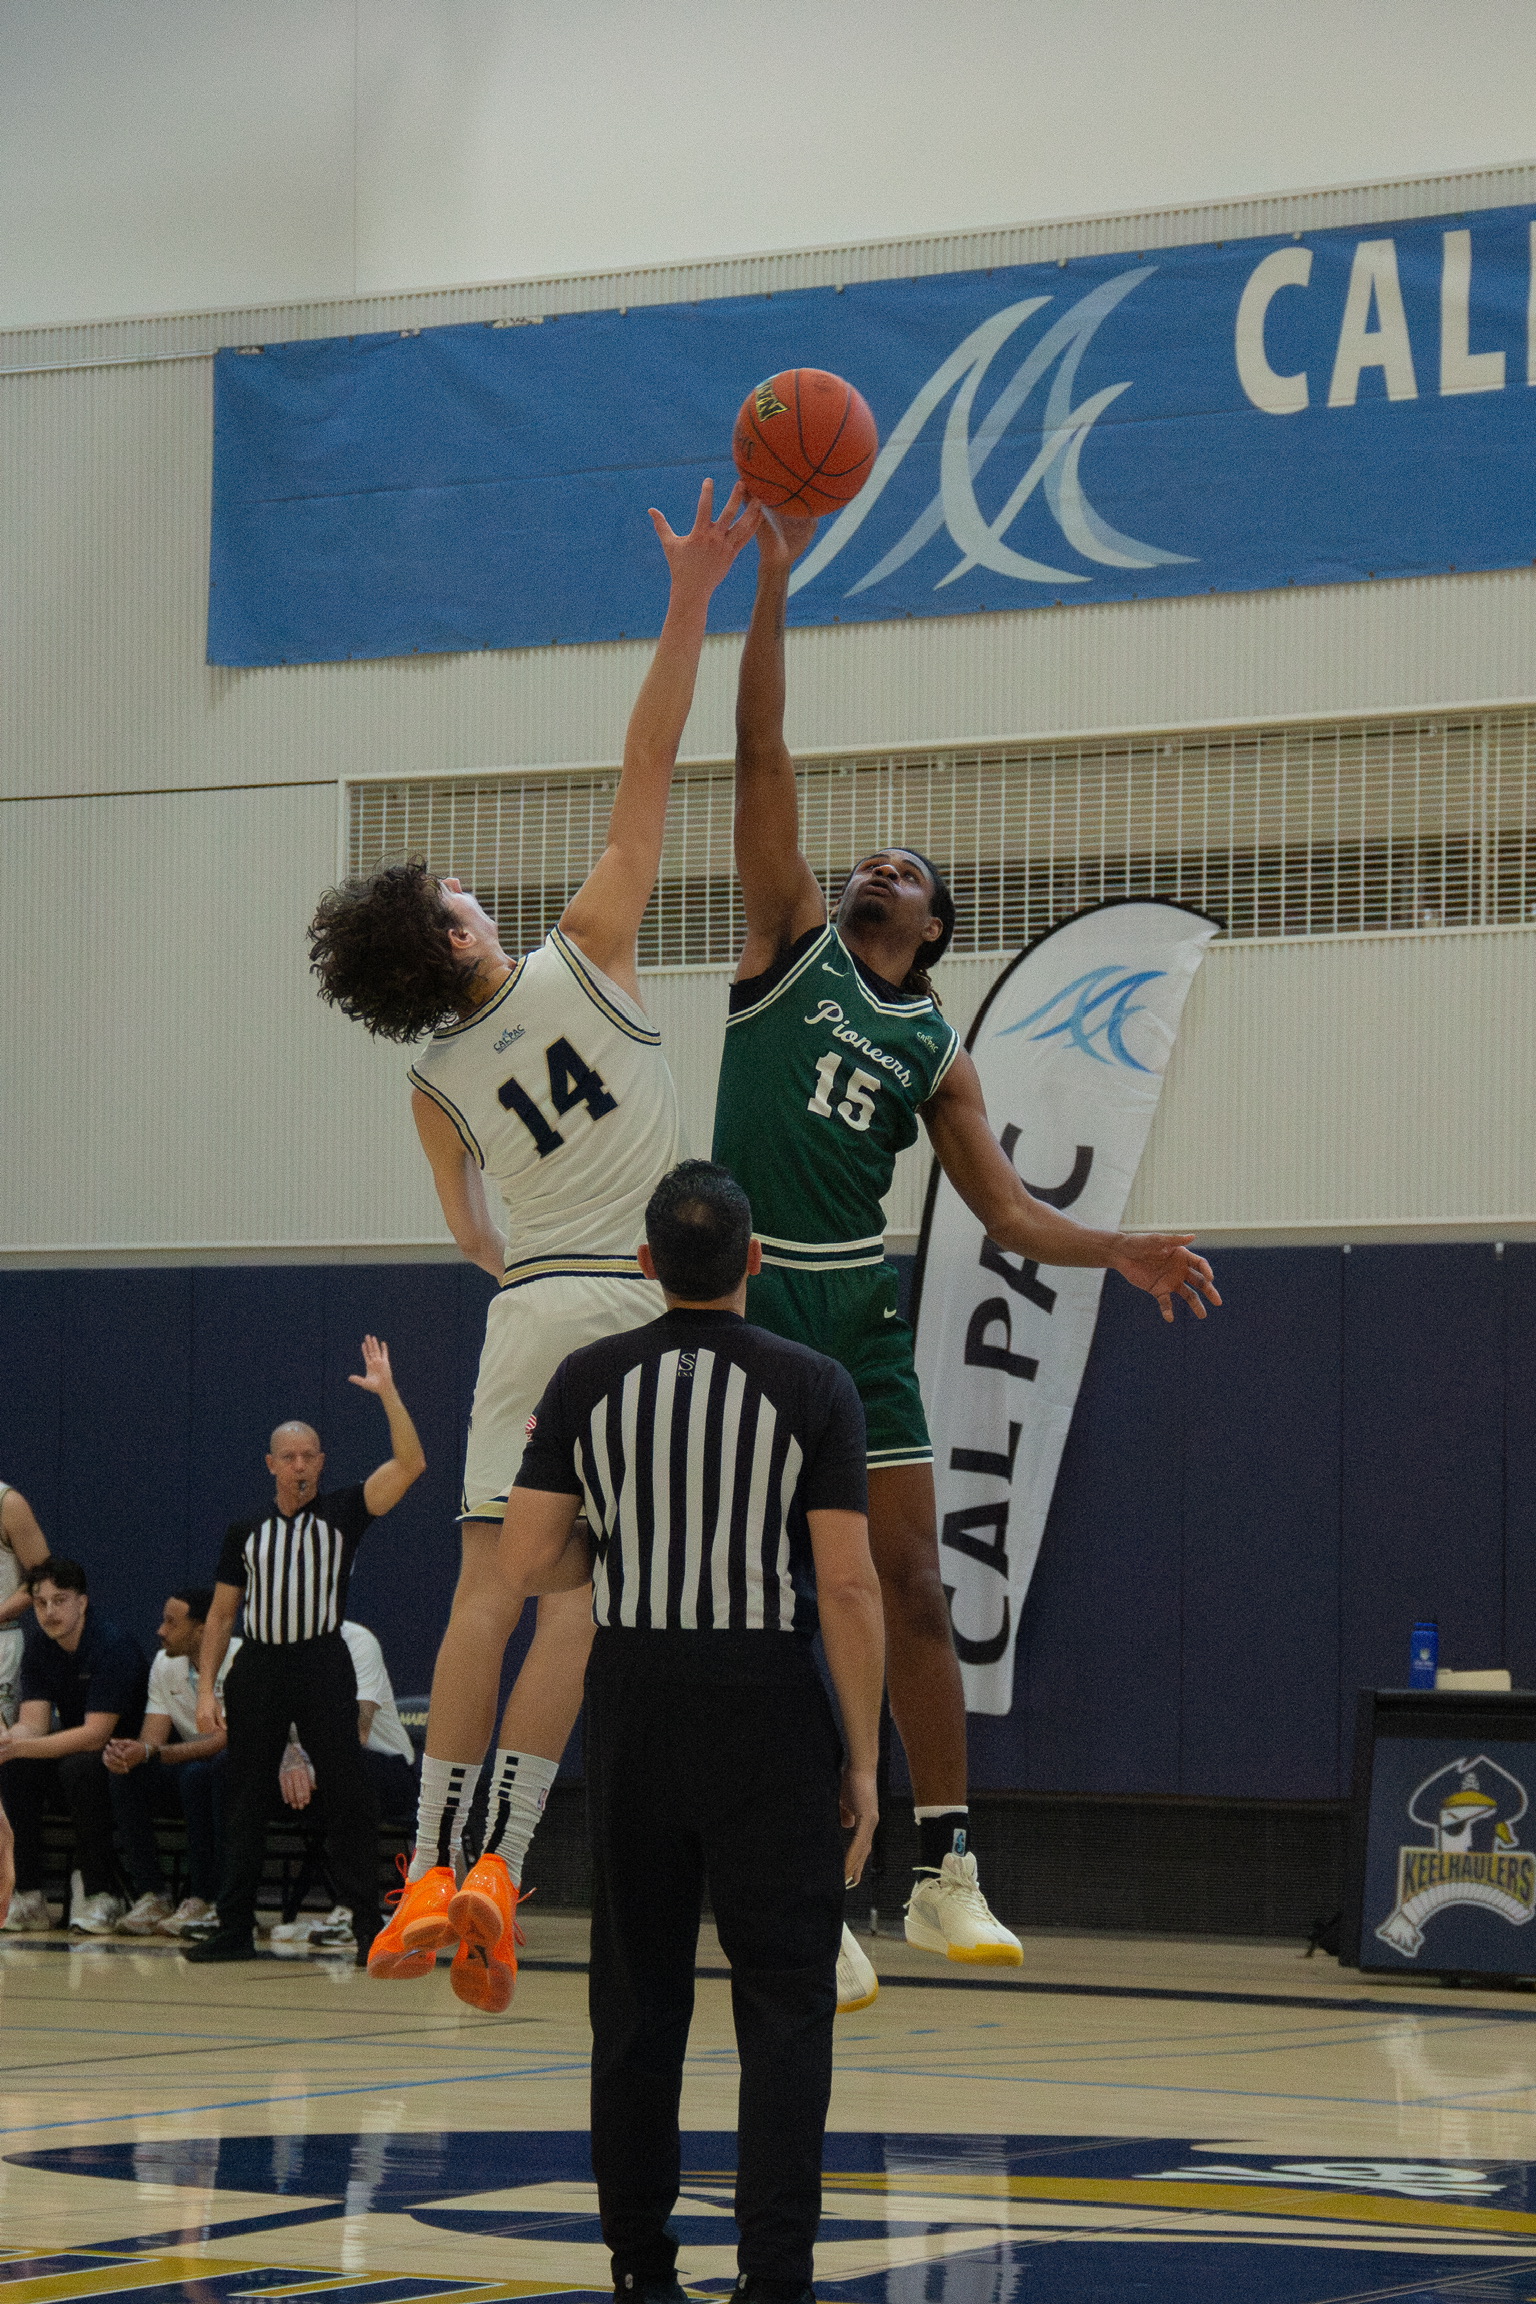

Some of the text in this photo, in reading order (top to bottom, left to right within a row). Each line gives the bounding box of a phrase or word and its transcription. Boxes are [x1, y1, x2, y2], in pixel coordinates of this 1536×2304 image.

[1235, 219, 1536, 415] CAL
[498, 1035, 619, 1159] 14
[804, 1000, 912, 1088] Pioneers
[807, 1051, 881, 1132] 15
[941, 1420, 1022, 1666] CAL
[1404, 1853, 1532, 1902] KEELHAULERS
